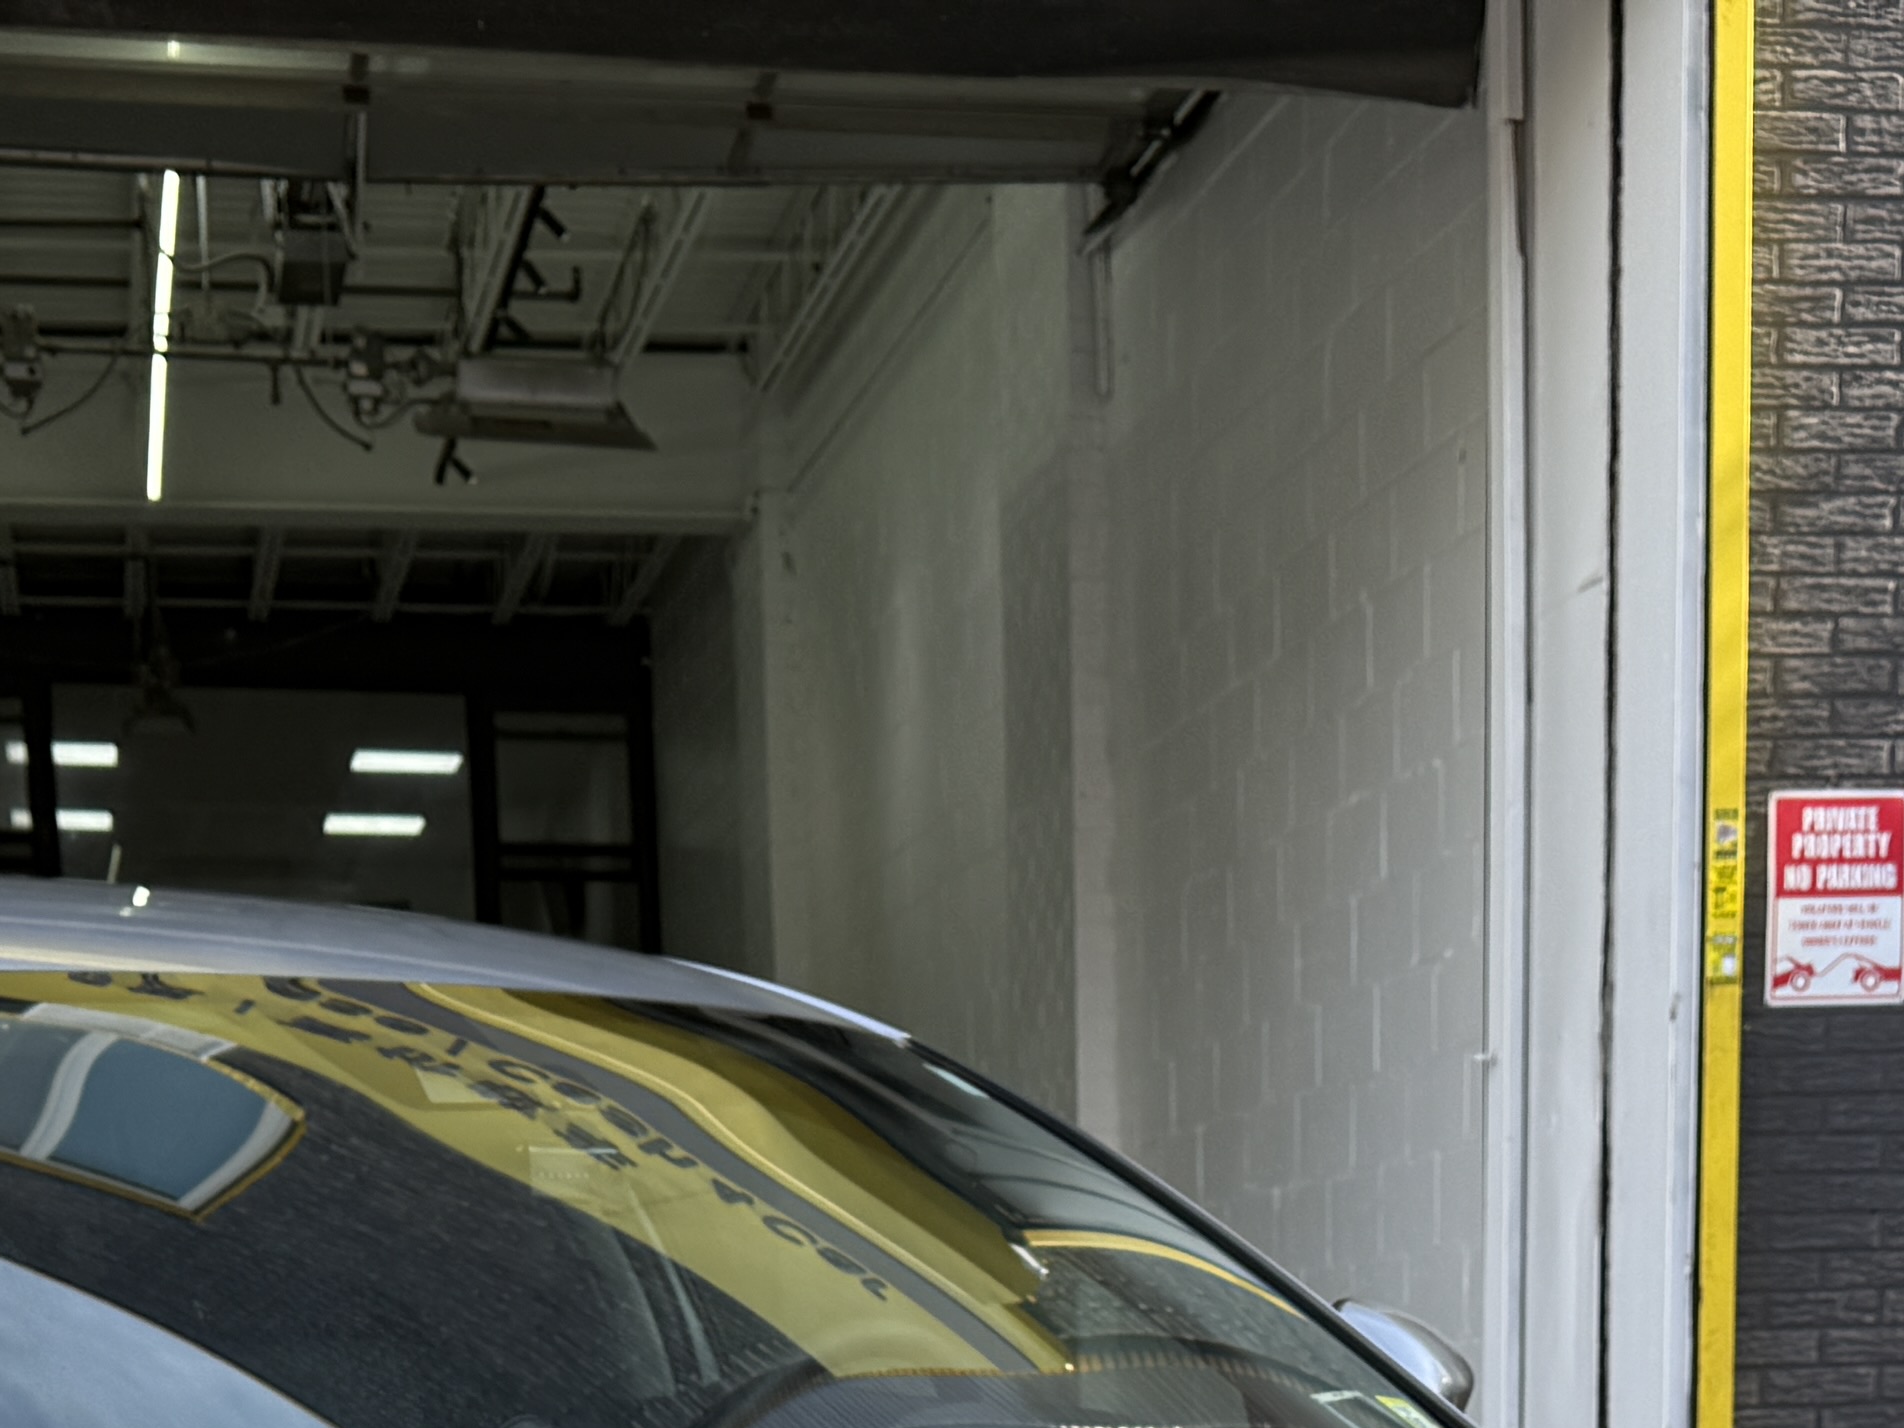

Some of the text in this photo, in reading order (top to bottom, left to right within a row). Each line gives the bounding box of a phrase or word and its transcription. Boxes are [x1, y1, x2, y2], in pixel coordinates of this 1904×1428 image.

[1801, 806, 1880, 831] PRIVATE
[1791, 832, 1892, 860] PROPERTY
[1783, 863, 1898, 891] NO PARKING
